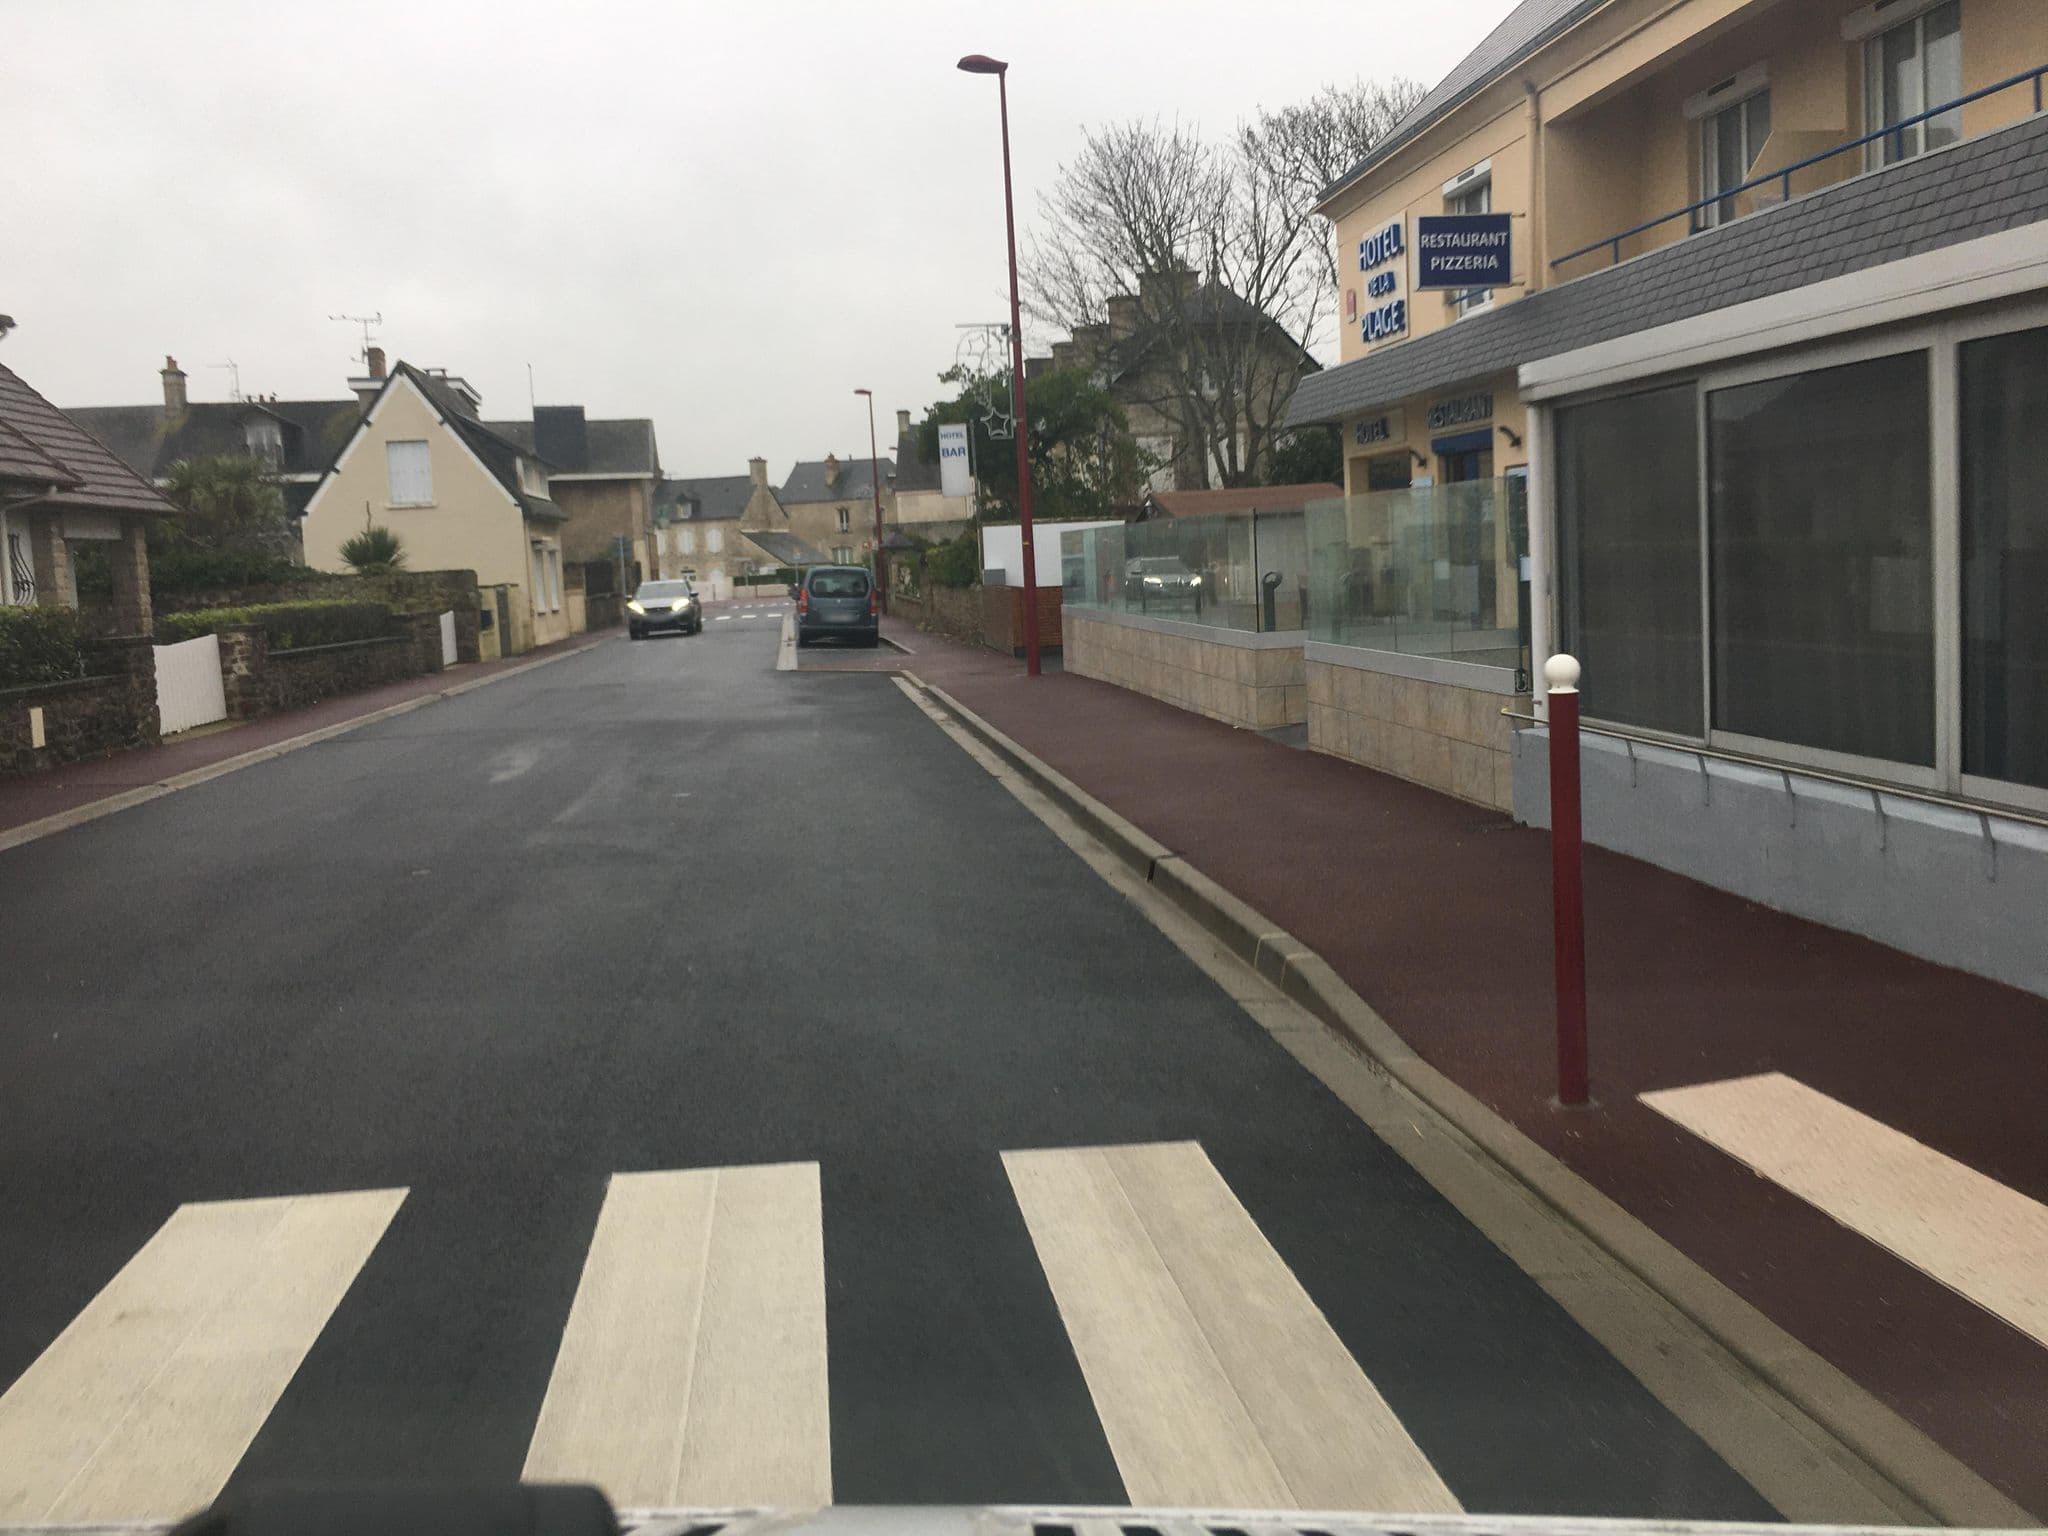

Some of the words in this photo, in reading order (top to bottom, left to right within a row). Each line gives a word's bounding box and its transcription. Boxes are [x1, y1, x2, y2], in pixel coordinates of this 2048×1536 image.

[1359, 223, 1404, 272] HOTEL
[1420, 231, 1508, 249] RESTAURANT
[1430, 254, 1499, 271] PIZZERIA
[1360, 299, 1406, 343] PLAGE
[940, 431, 964, 440] HOTEL
[941, 447, 966, 457] BAR
